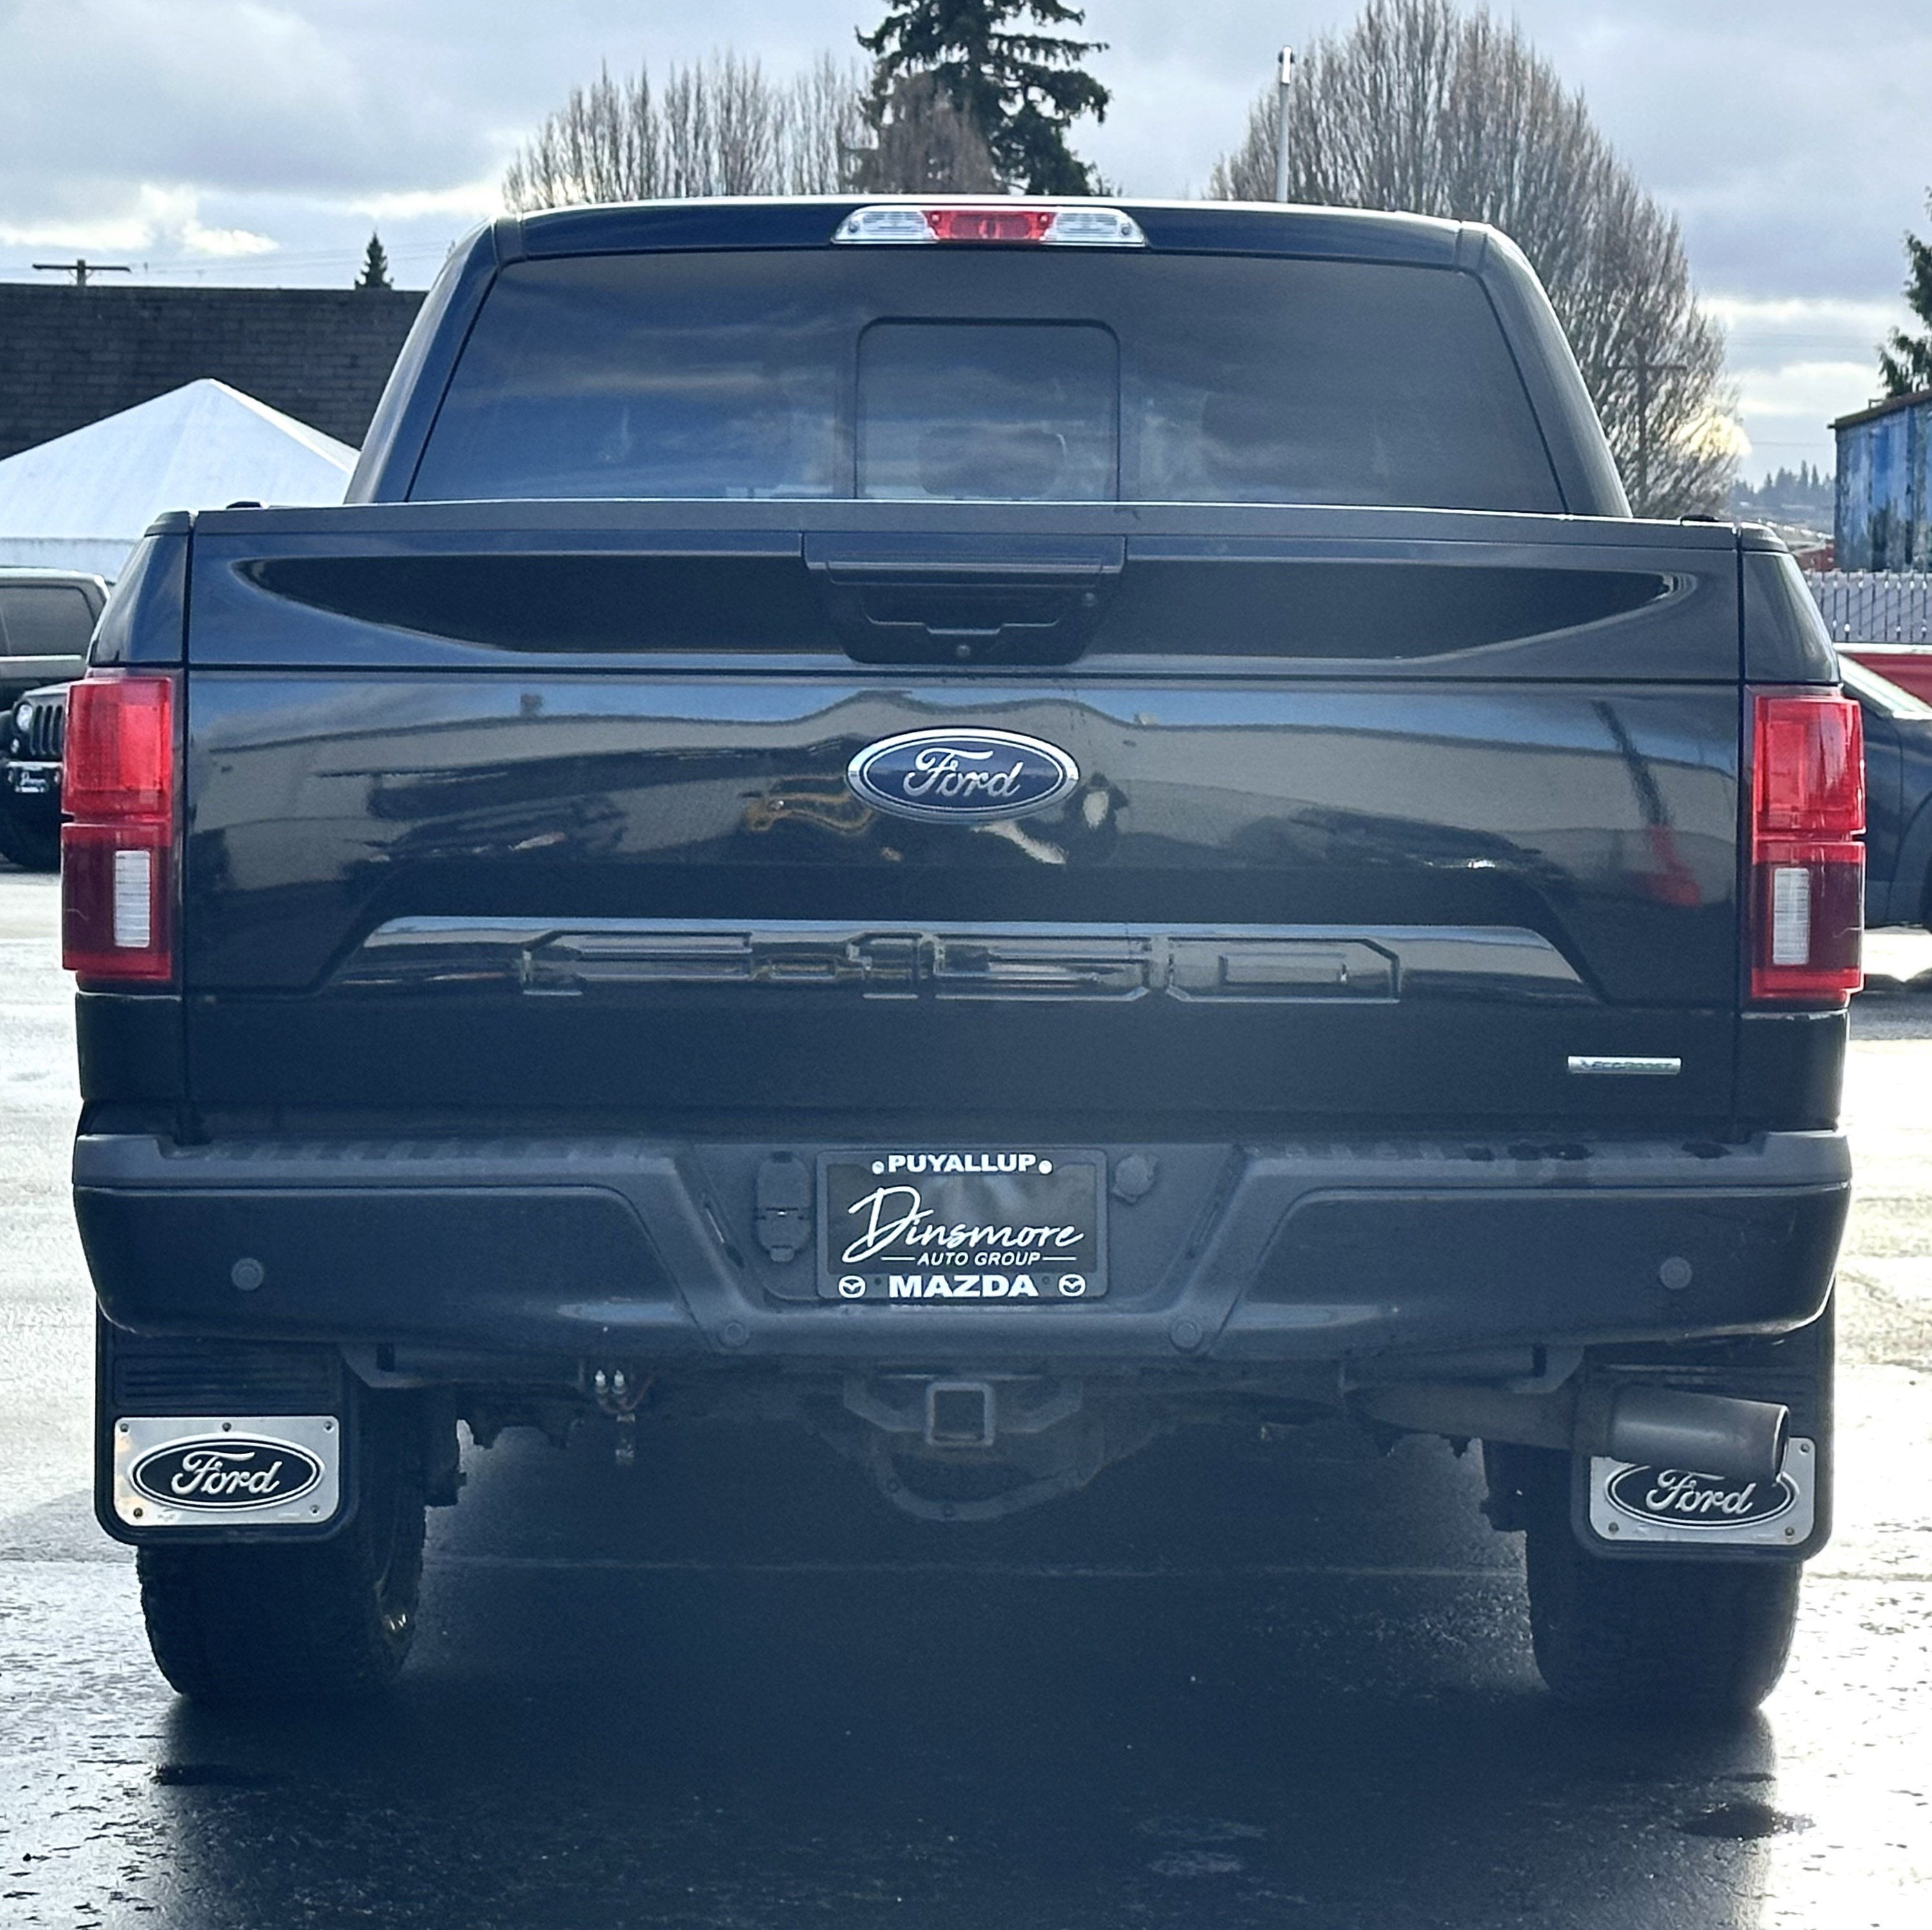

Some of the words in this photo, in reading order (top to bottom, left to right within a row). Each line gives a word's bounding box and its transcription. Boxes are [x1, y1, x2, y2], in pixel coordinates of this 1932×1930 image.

[903, 747, 1024, 796] Ford
[888, 1154, 1037, 1173] PUYALLUP
[841, 1185, 1084, 1263] Dinsmore
[917, 1252, 968, 1266] AUTO
[974, 1252, 1041, 1266] GROUP
[889, 1274, 1038, 1298] MAZDA
[171, 1450, 283, 1495] Ford
[1645, 1469, 1757, 1515] Ford
